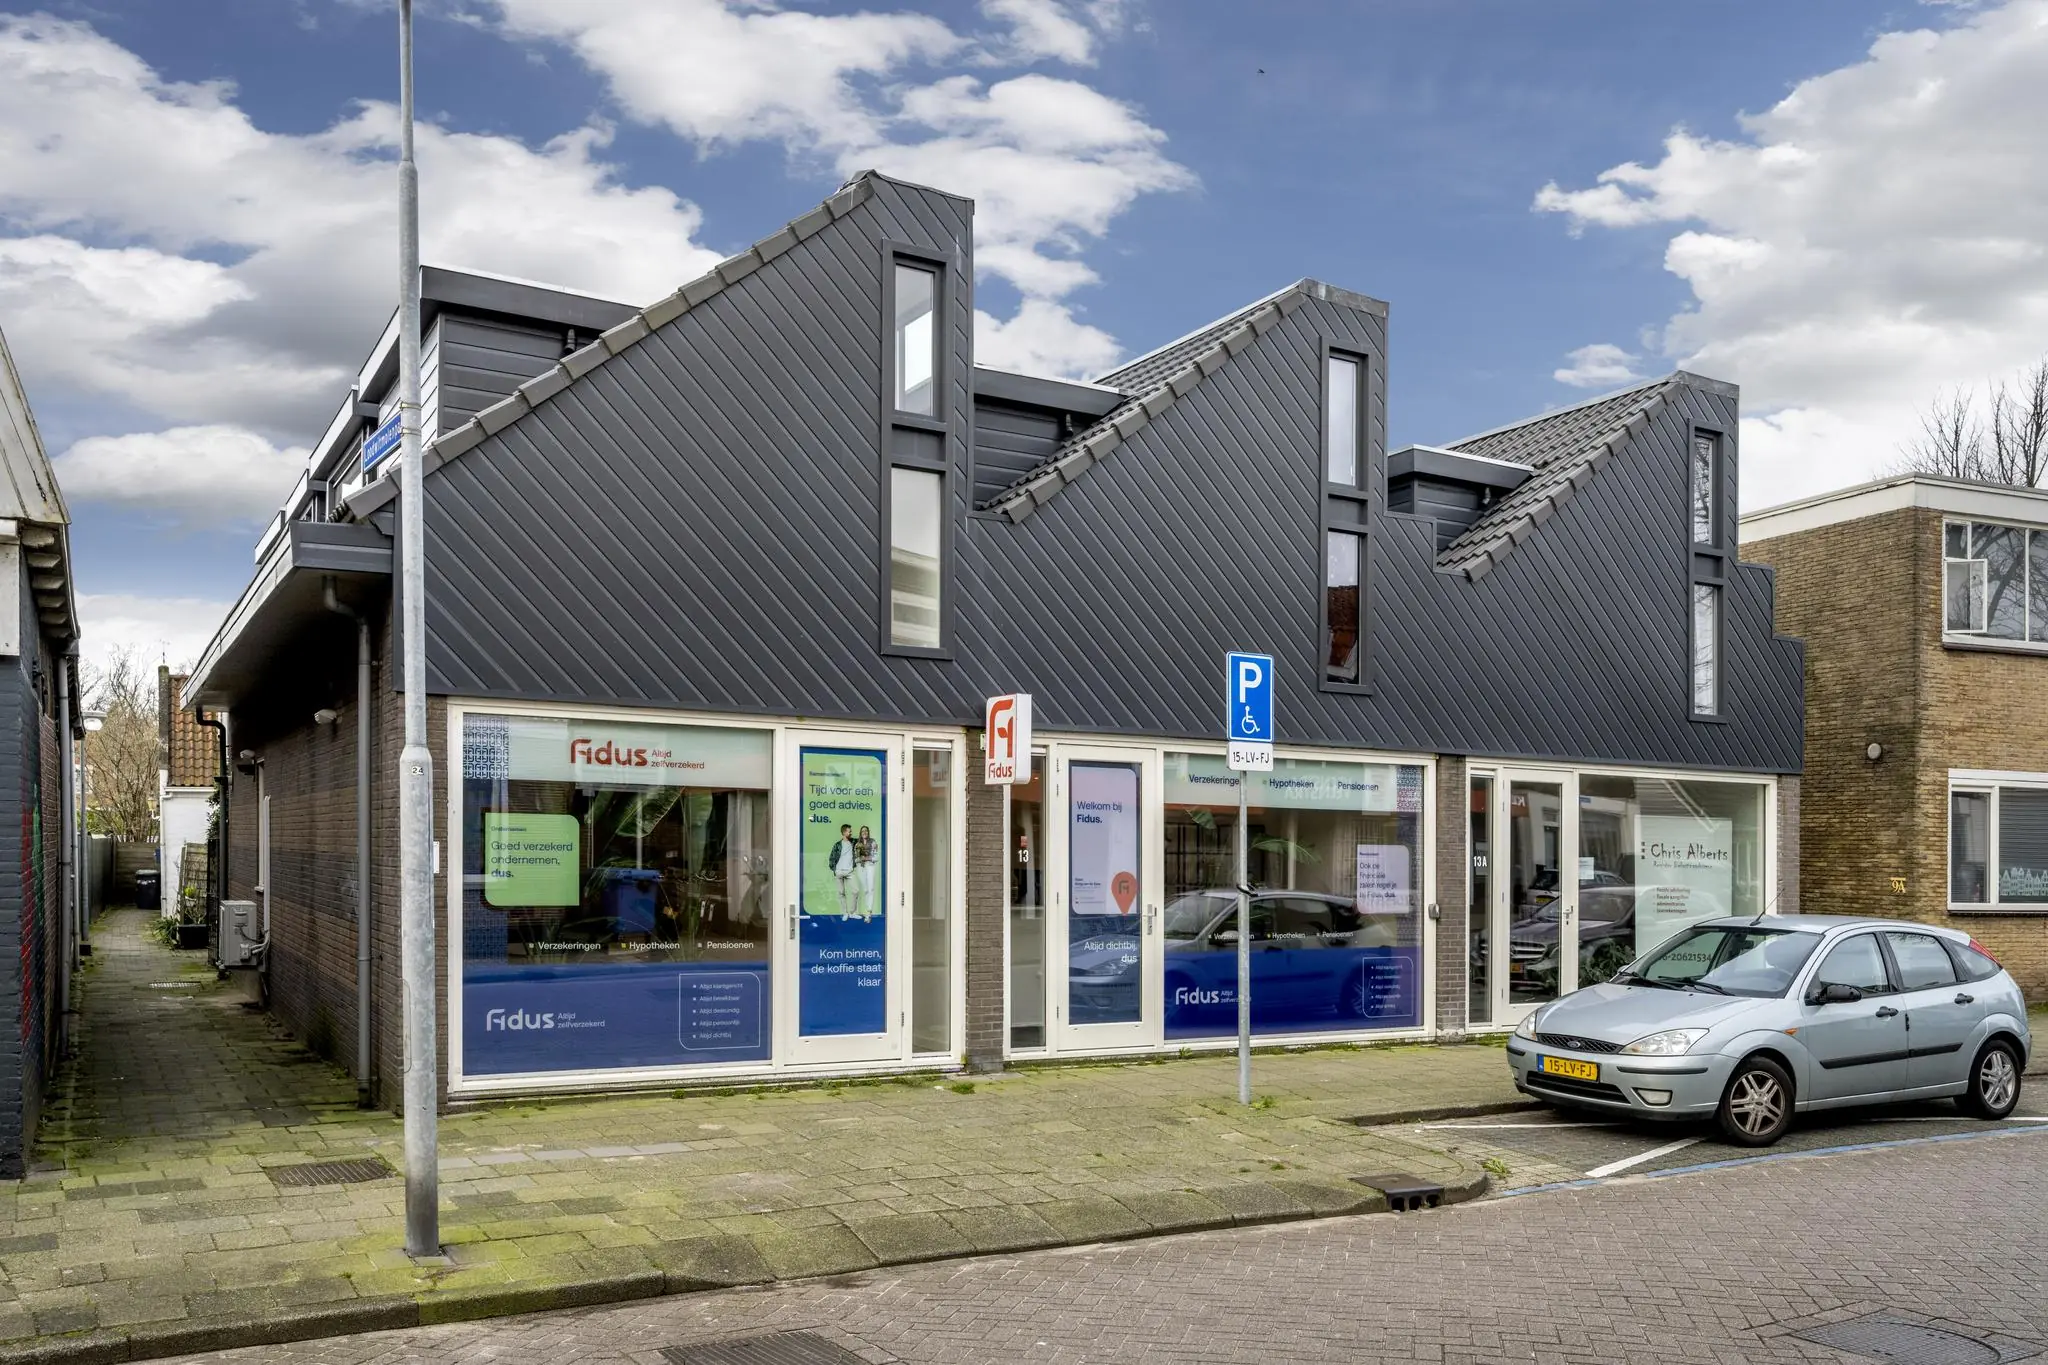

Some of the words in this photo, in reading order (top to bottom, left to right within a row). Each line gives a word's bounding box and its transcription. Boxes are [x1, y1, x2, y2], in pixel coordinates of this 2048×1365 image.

[1240, 662, 1262, 703] P
[570, 738, 648, 767] Fidus
[652, 749, 672, 760] Altijd
[1233, 751, 1270, 764] 15-LV-FJ
[651, 760, 705, 769] zelfverzekerd
[412, 767, 424, 775] 24
[989, 762, 1012, 779] Fidus
[1188, 774, 1240, 787] Verzekeringe
[1269, 778, 1314, 789] Hypotheken
[1337, 781, 1379, 792] Pensioenen
[809, 784, 827, 796] Tijd
[830, 787, 852, 796] voor
[855, 787, 874, 796] een
[809, 800, 836, 811] goed
[838, 800, 873, 811] advies,
[1076, 801, 1111, 811] Welkom
[1112, 801, 1122, 813] bij
[809, 813, 832, 824] dus.
[1076, 814, 1103, 824] Fidus.
[491, 840, 520, 851] Goed
[523, 841, 573, 852] verzekerd
[1650, 842, 1681, 860] Chris
[1687, 843, 1728, 861] Alberts
[1018, 849, 1029, 863] 13
[491, 868, 514, 878] dus.
[1272, 931, 1306, 941] Hypotheken
[537, 941, 601, 951] Verzekeringen
[629, 941, 680, 951] Hypotheken
[707, 941, 754, 949] Pensioenen
[1084, 941, 1104, 952] Altijd
[819, 949, 843, 959] Kom
[845, 949, 882, 960] binnen,
[1121, 954, 1138, 963] dus
[811, 964, 825, 973] de
[827, 963, 855, 973] koffie
[857, 964, 882, 973] staat
[857, 977, 882, 987] klaar
[1175, 986, 1220, 1005] Fidus
[486, 1008, 555, 1031] Fidus
[558, 1012, 576, 1021] Altijd
[557, 1020, 606, 1028] zelfverzekerd
[1549, 1059, 1592, 1077] 15-LV-FJ
